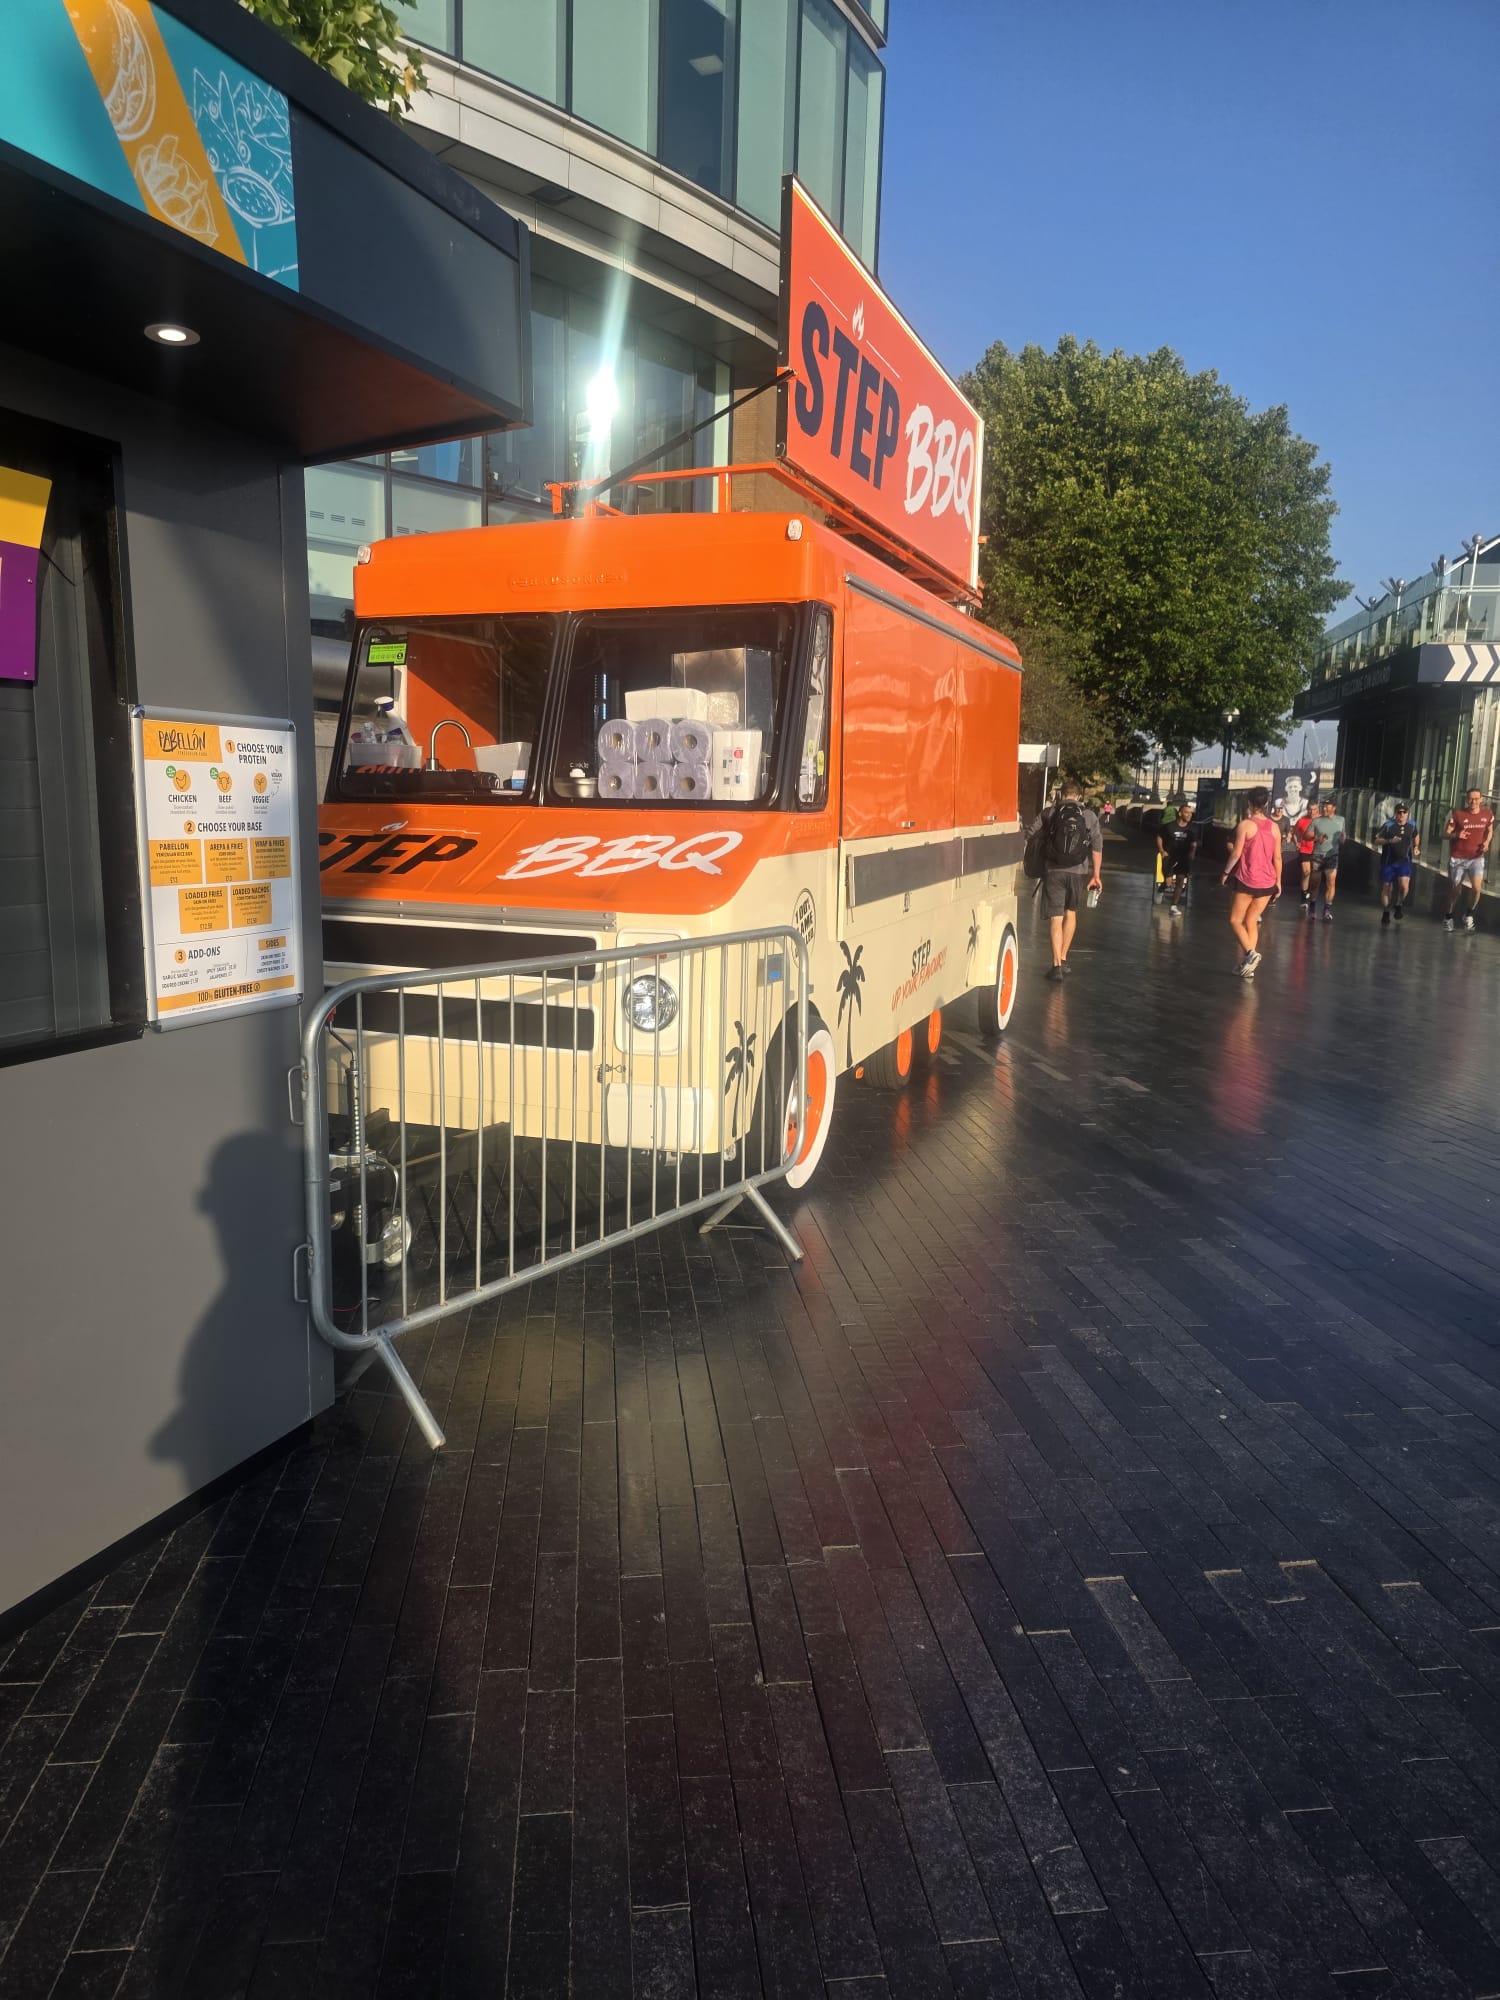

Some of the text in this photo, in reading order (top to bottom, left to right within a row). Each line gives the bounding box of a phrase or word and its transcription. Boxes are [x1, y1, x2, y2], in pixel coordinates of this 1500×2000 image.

[795, 301, 976, 532] STEP BBQ
[159, 728, 207, 752] PABELLÓN
[237, 742, 265, 754] CHOOSE
[267, 744, 283, 755] YOUR
[239, 754, 267, 765] PROTEIN
[168, 794, 197, 803] CHICKEN
[219, 795, 232, 803] BEEF
[187, 821, 262, 832] 2 CHOOSE YOUR BASE
[496, 830, 743, 880] BBQ
[185, 890, 223, 900] LOADED FRIES
[232, 887, 250, 896] LOADED
[265, 938, 279, 948] SIDES
[178, 946, 221, 961] 3 ADD-ONS
[912, 939, 931, 977] STEP
[214, 982, 253, 1000] GLUTEN-FREE
